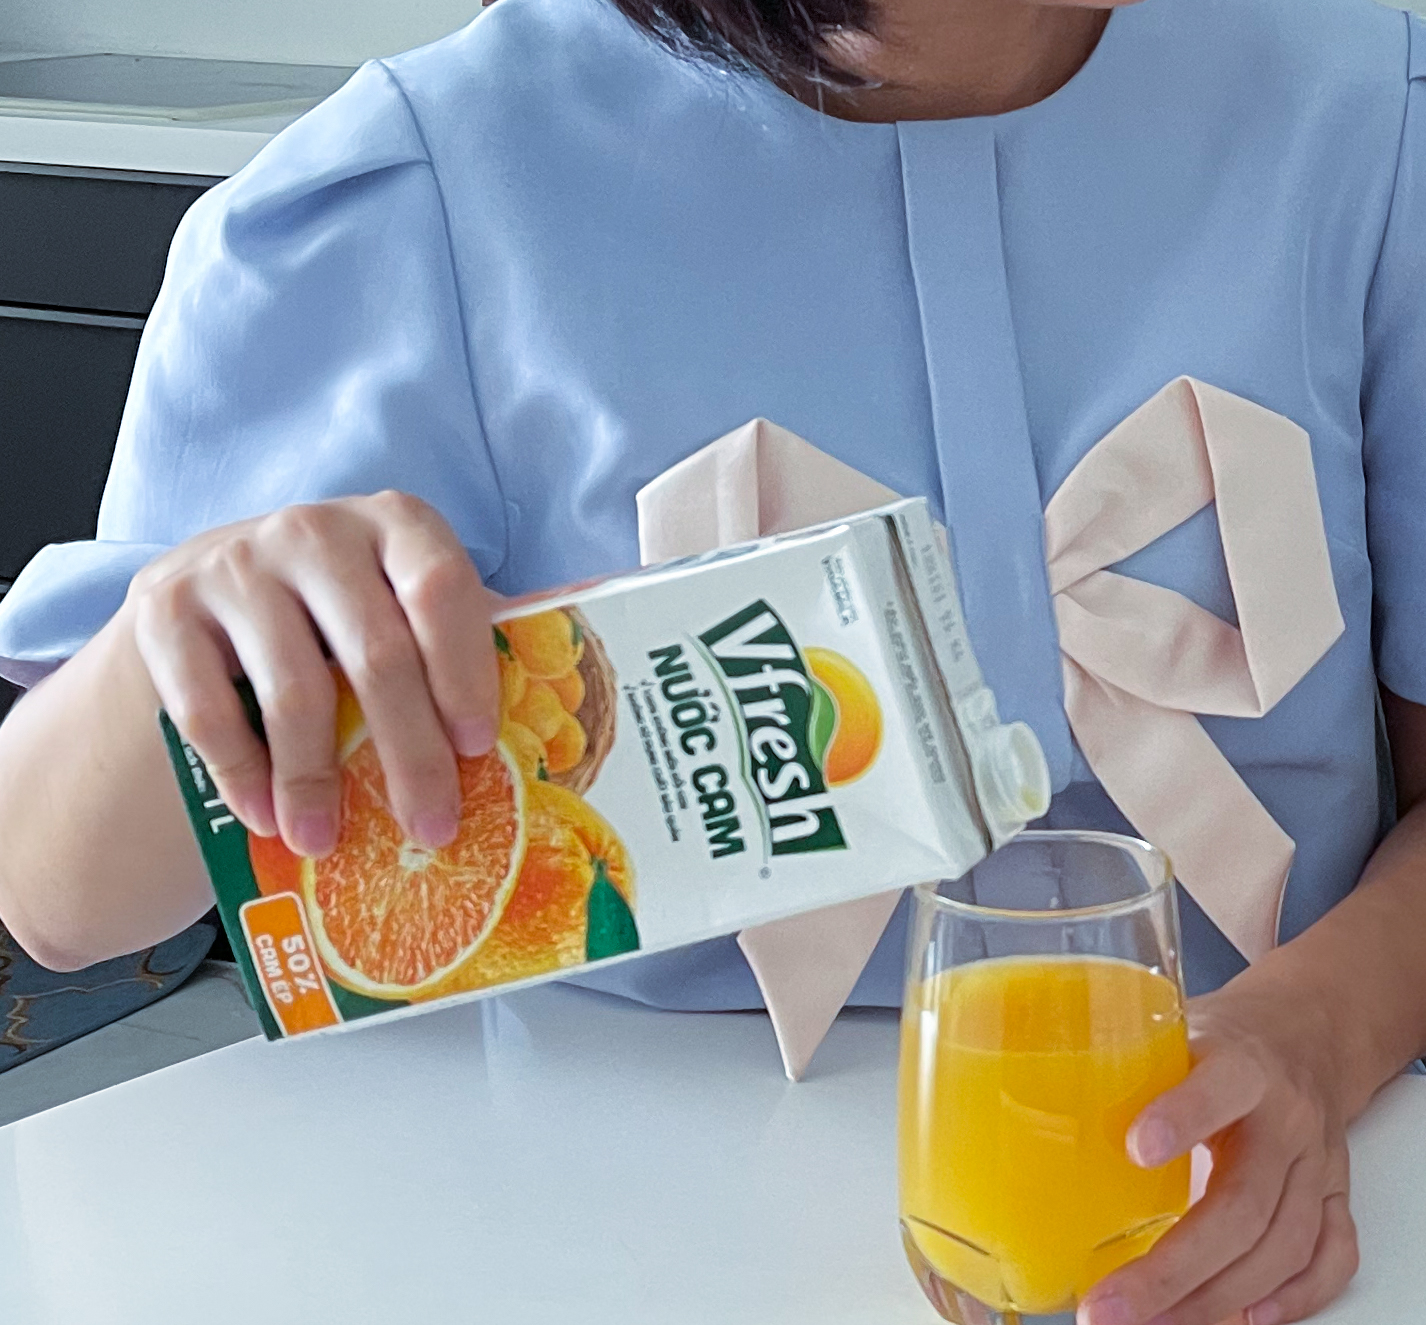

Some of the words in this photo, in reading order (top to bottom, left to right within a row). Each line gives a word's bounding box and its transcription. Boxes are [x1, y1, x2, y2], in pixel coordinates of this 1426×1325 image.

[646, 643, 720, 756] NƯỚC
[691, 763, 747, 859] CAM
[708, 610, 835, 844] Vfresh
[255, 933, 285, 979] CAM
[281, 934, 320, 994] 50%
